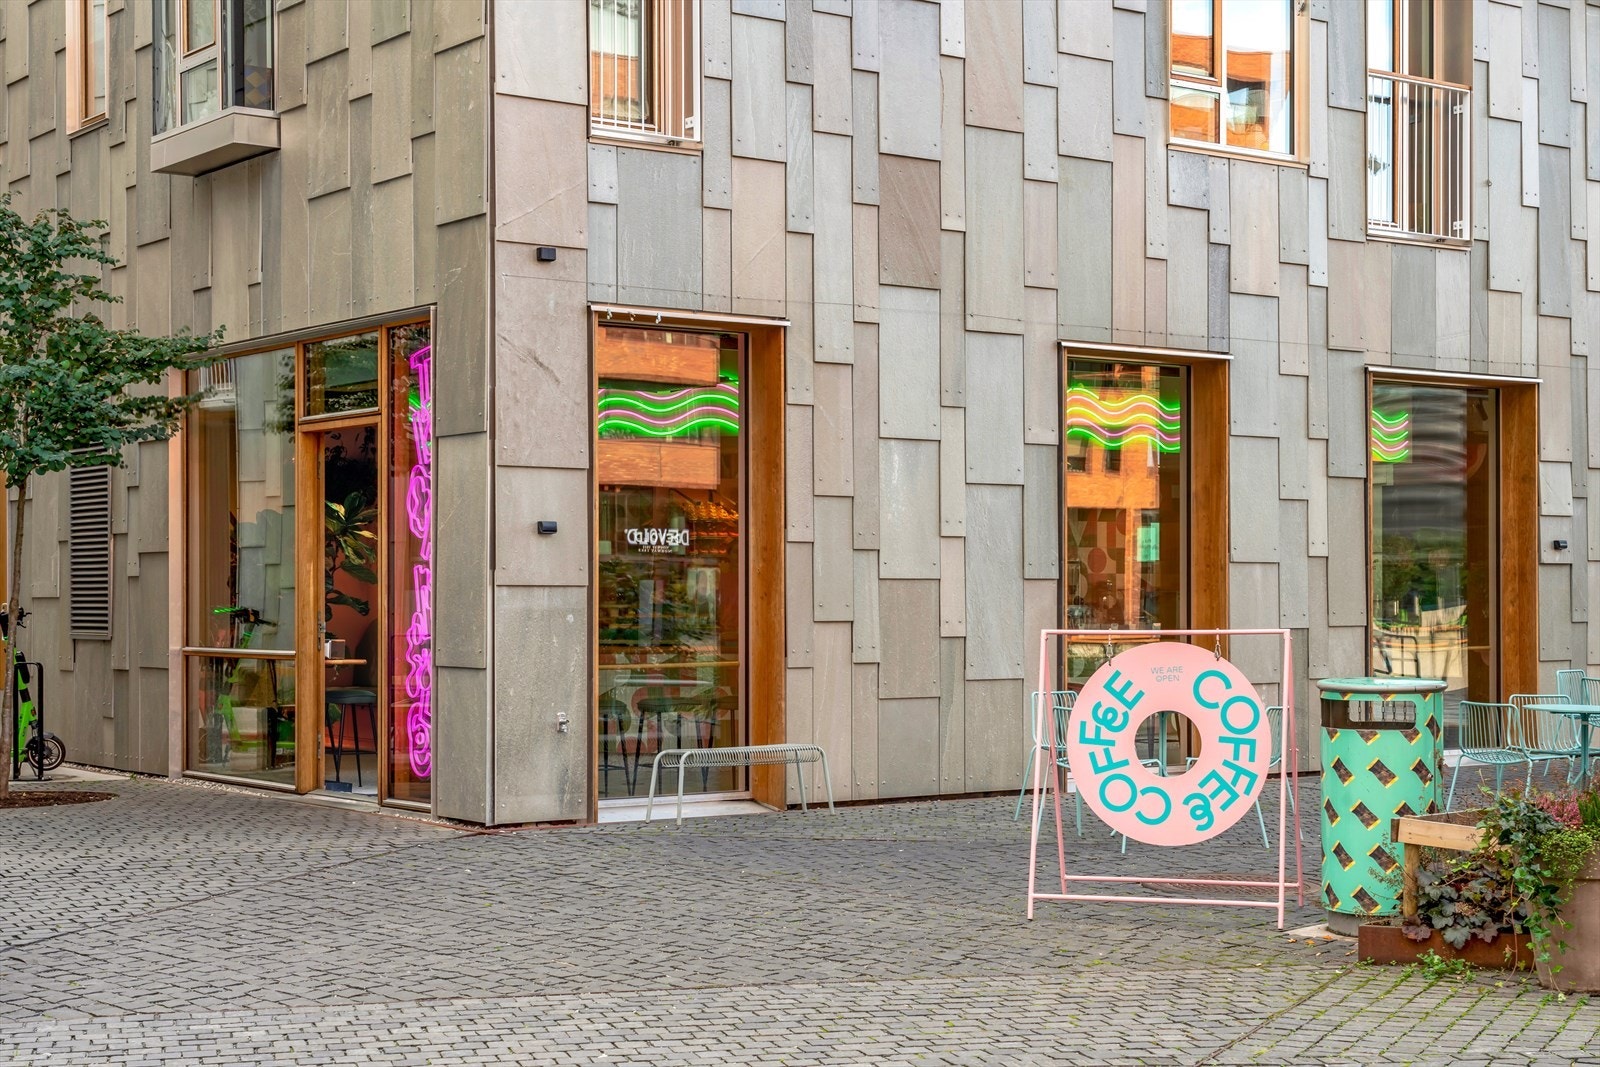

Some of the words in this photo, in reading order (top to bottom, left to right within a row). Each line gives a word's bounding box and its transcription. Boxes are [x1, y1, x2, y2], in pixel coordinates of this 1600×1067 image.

[1150, 666, 1165, 674] WE
[1166, 665, 1184, 673] ARE
[1155, 674, 1180, 682] OPEN
